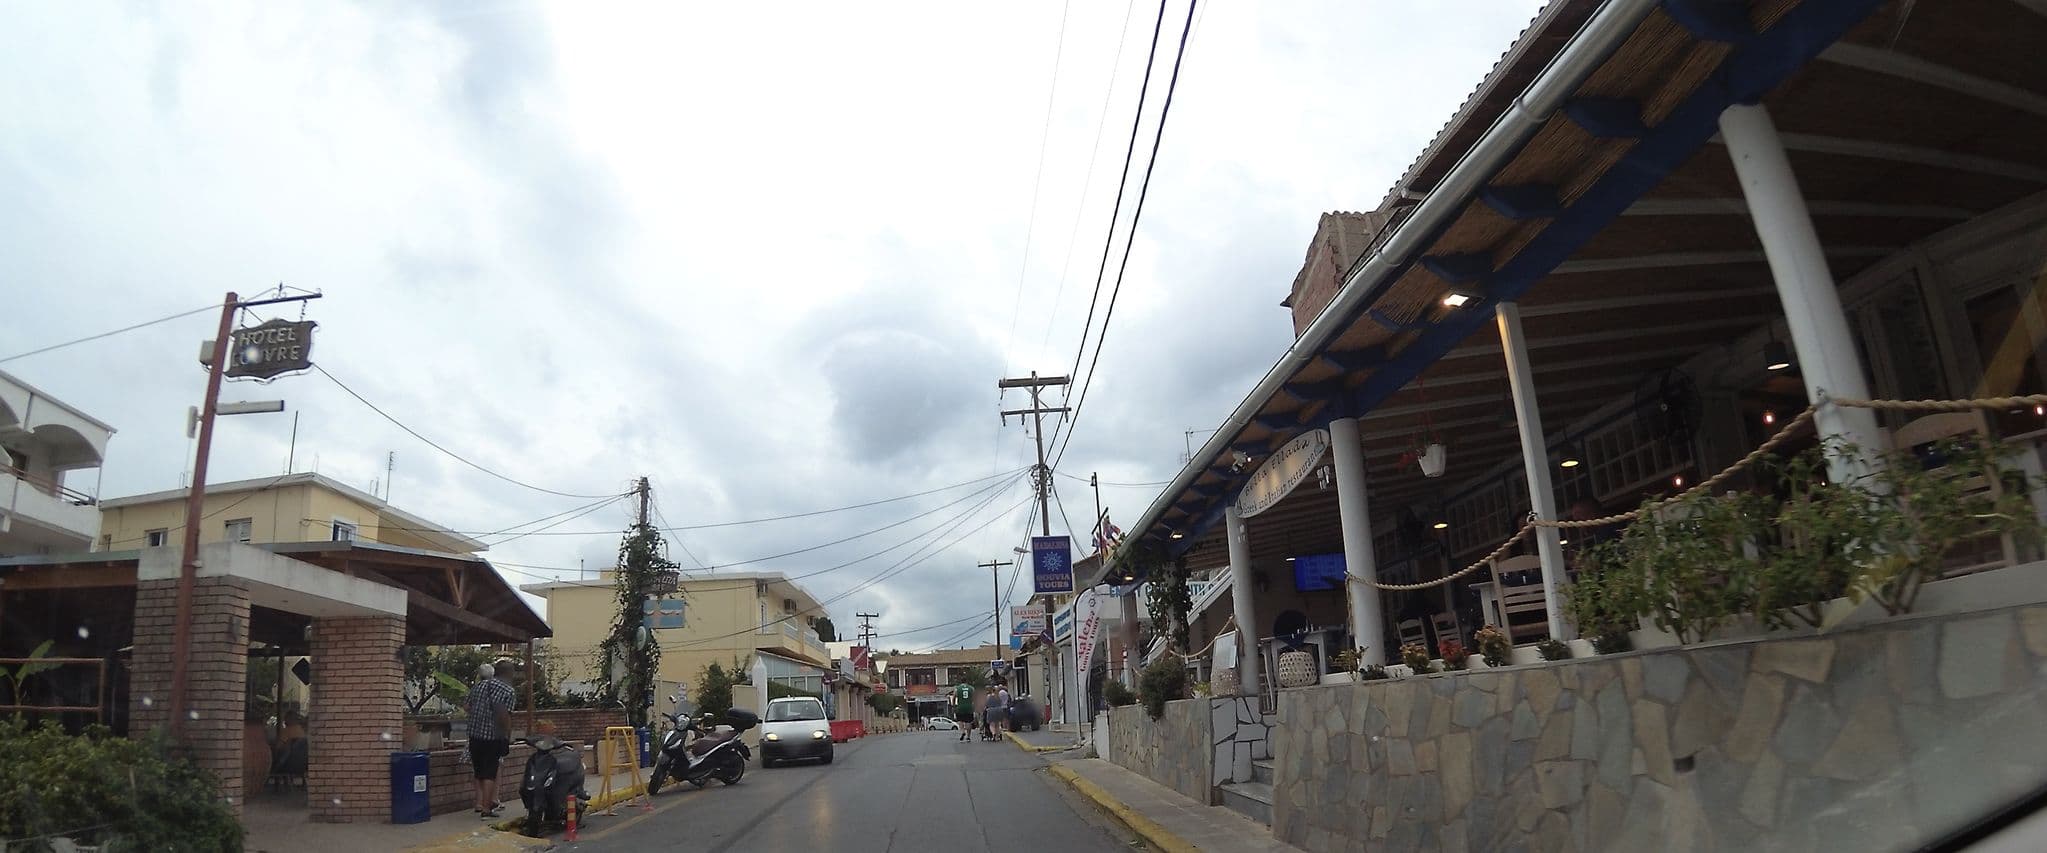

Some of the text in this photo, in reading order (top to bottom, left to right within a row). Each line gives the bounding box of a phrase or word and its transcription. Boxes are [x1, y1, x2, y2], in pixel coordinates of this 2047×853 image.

[240, 327, 296, 345] HOTEL
[232, 345, 301, 367] LOVRE
[1039, 580, 1070, 589] TOURS
